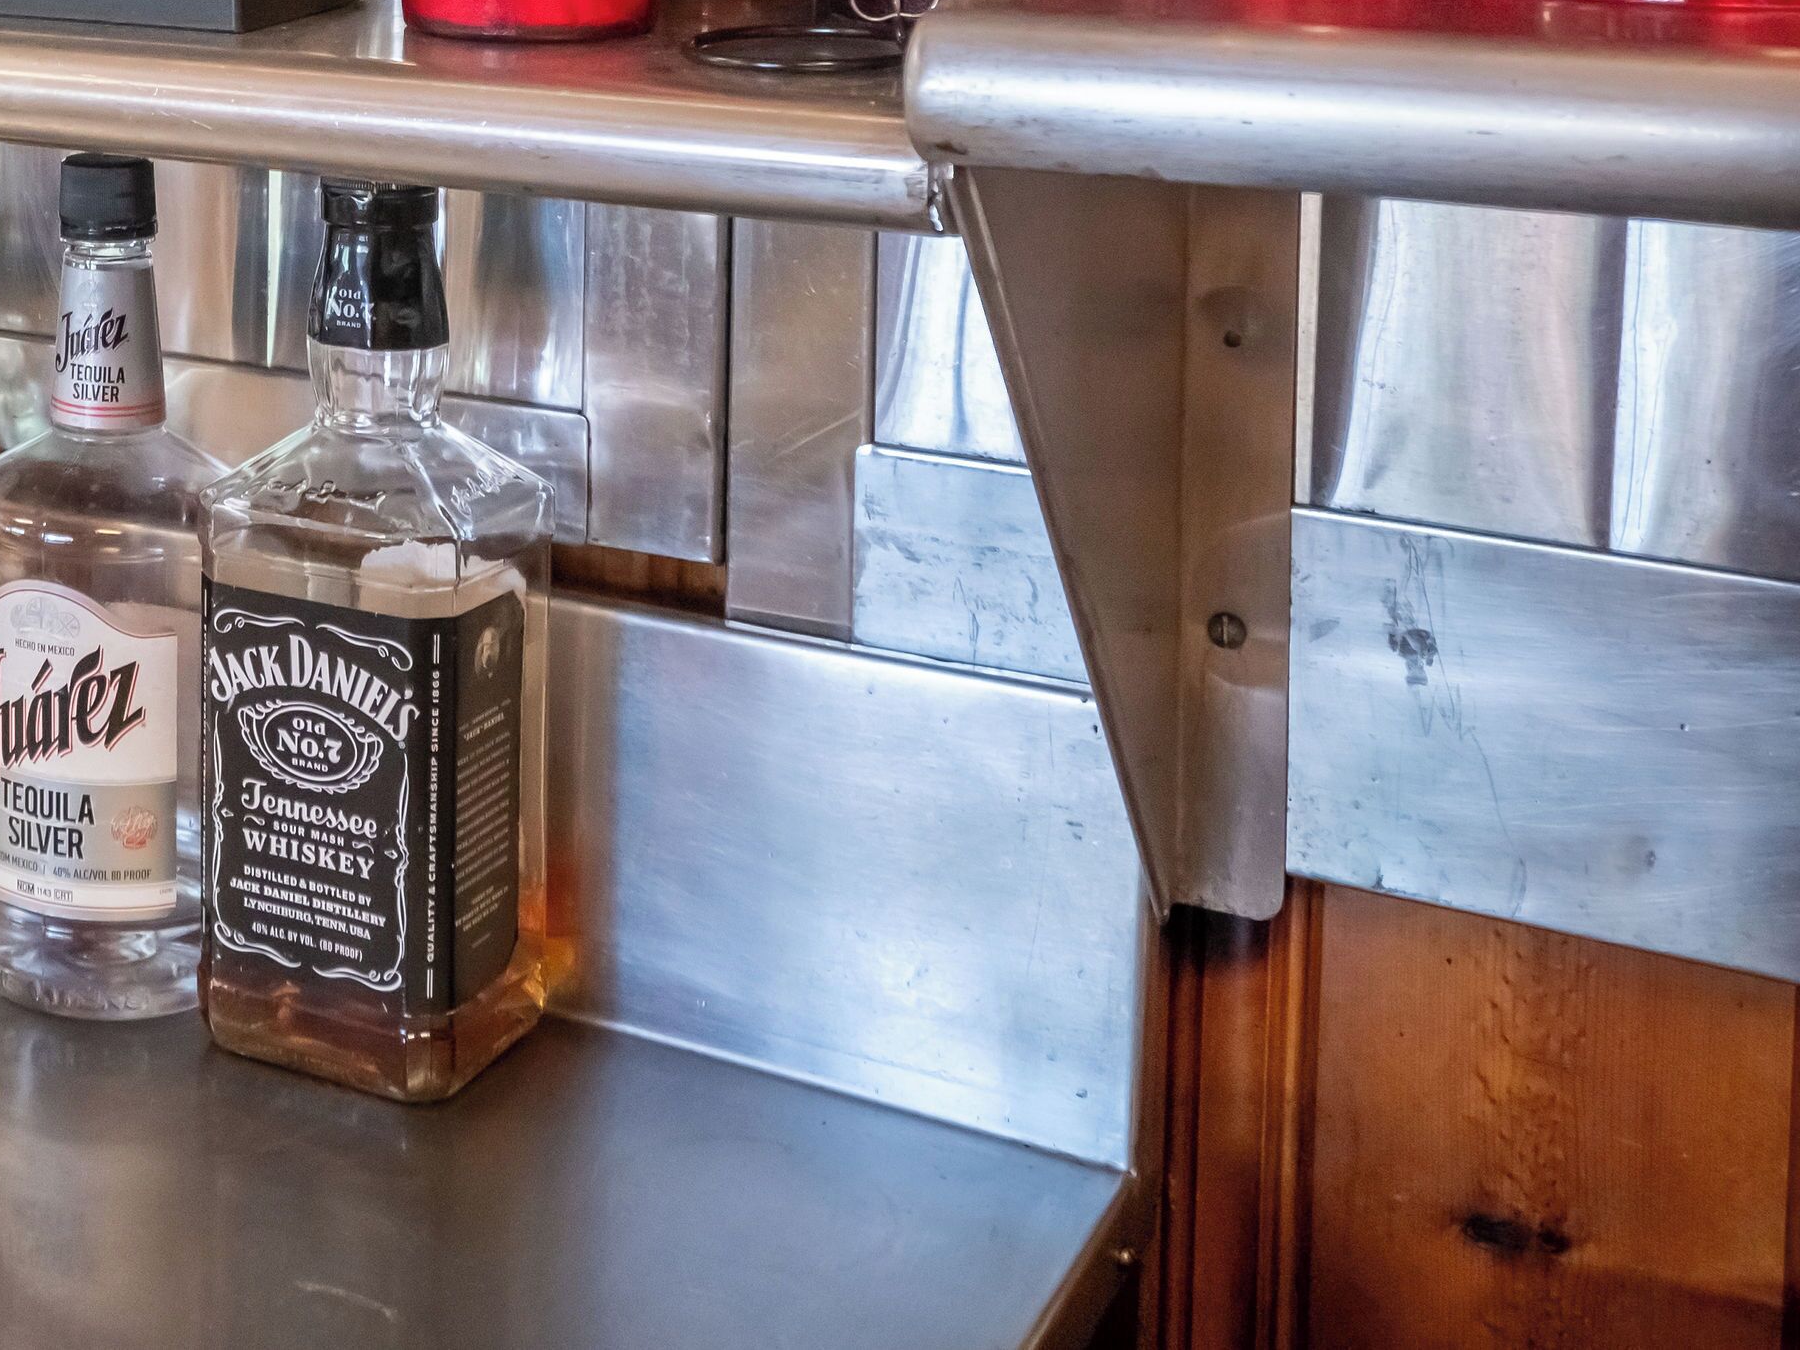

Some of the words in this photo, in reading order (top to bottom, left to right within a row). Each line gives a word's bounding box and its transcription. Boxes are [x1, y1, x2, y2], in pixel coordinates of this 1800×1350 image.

[336, 320, 361, 329] BRAND
[70, 363, 126, 384] TEQUILA
[73, 383, 120, 402] SILVER
[14, 638, 36, 651] HECHO
[37, 643, 46, 653] EN
[47, 644, 75, 656] MEXICO
[209, 645, 288, 703] JACK
[288, 634, 421, 742] DANIEL'S
[432, 670, 440, 703] 1866
[292, 718, 326, 736] Old
[431, 707, 439, 752] SINCE
[292, 757, 329, 773] BRAND
[1, 778, 96, 826] TEQUILA
[241, 777, 378, 839] Tennessee
[429, 756, 438, 882] CRAFTSMANSHIP
[8, 816, 84, 860] SILVER
[242, 827, 375, 880] WHISKEY
[272, 821, 306, 837] SOUR
[310, 829, 345, 847] MASH
[11, 856, 38, 872] MEXICO
[52, 866, 71, 878] 40%
[73, 869, 109, 881] ALC/VOL
[111, 870, 122, 881] 80
[124, 869, 152, 881] PROOF
[243, 865, 298, 887] DISTILLED
[299, 879, 307, 890] &
[309, 881, 356, 902] BOTTLED
[358, 893, 372, 907] BY
[230, 877, 261, 894] JACK
[263, 885, 310, 906] DANIEL
[312, 897, 387, 928] DISTILLERY
[428, 884, 437, 895] &
[243, 897, 314, 925] LYNCHBURG,
[314, 914, 348, 933] TENN.
[349, 923, 371, 940] USA
[427, 899, 436, 963] QUALITY
[251, 921, 268, 935] 40%
[269, 924, 286, 939] ALC.
[287, 931, 298, 943] BY
[299, 932, 317, 948] VOL.
[334, 941, 363, 962] PROOF)
